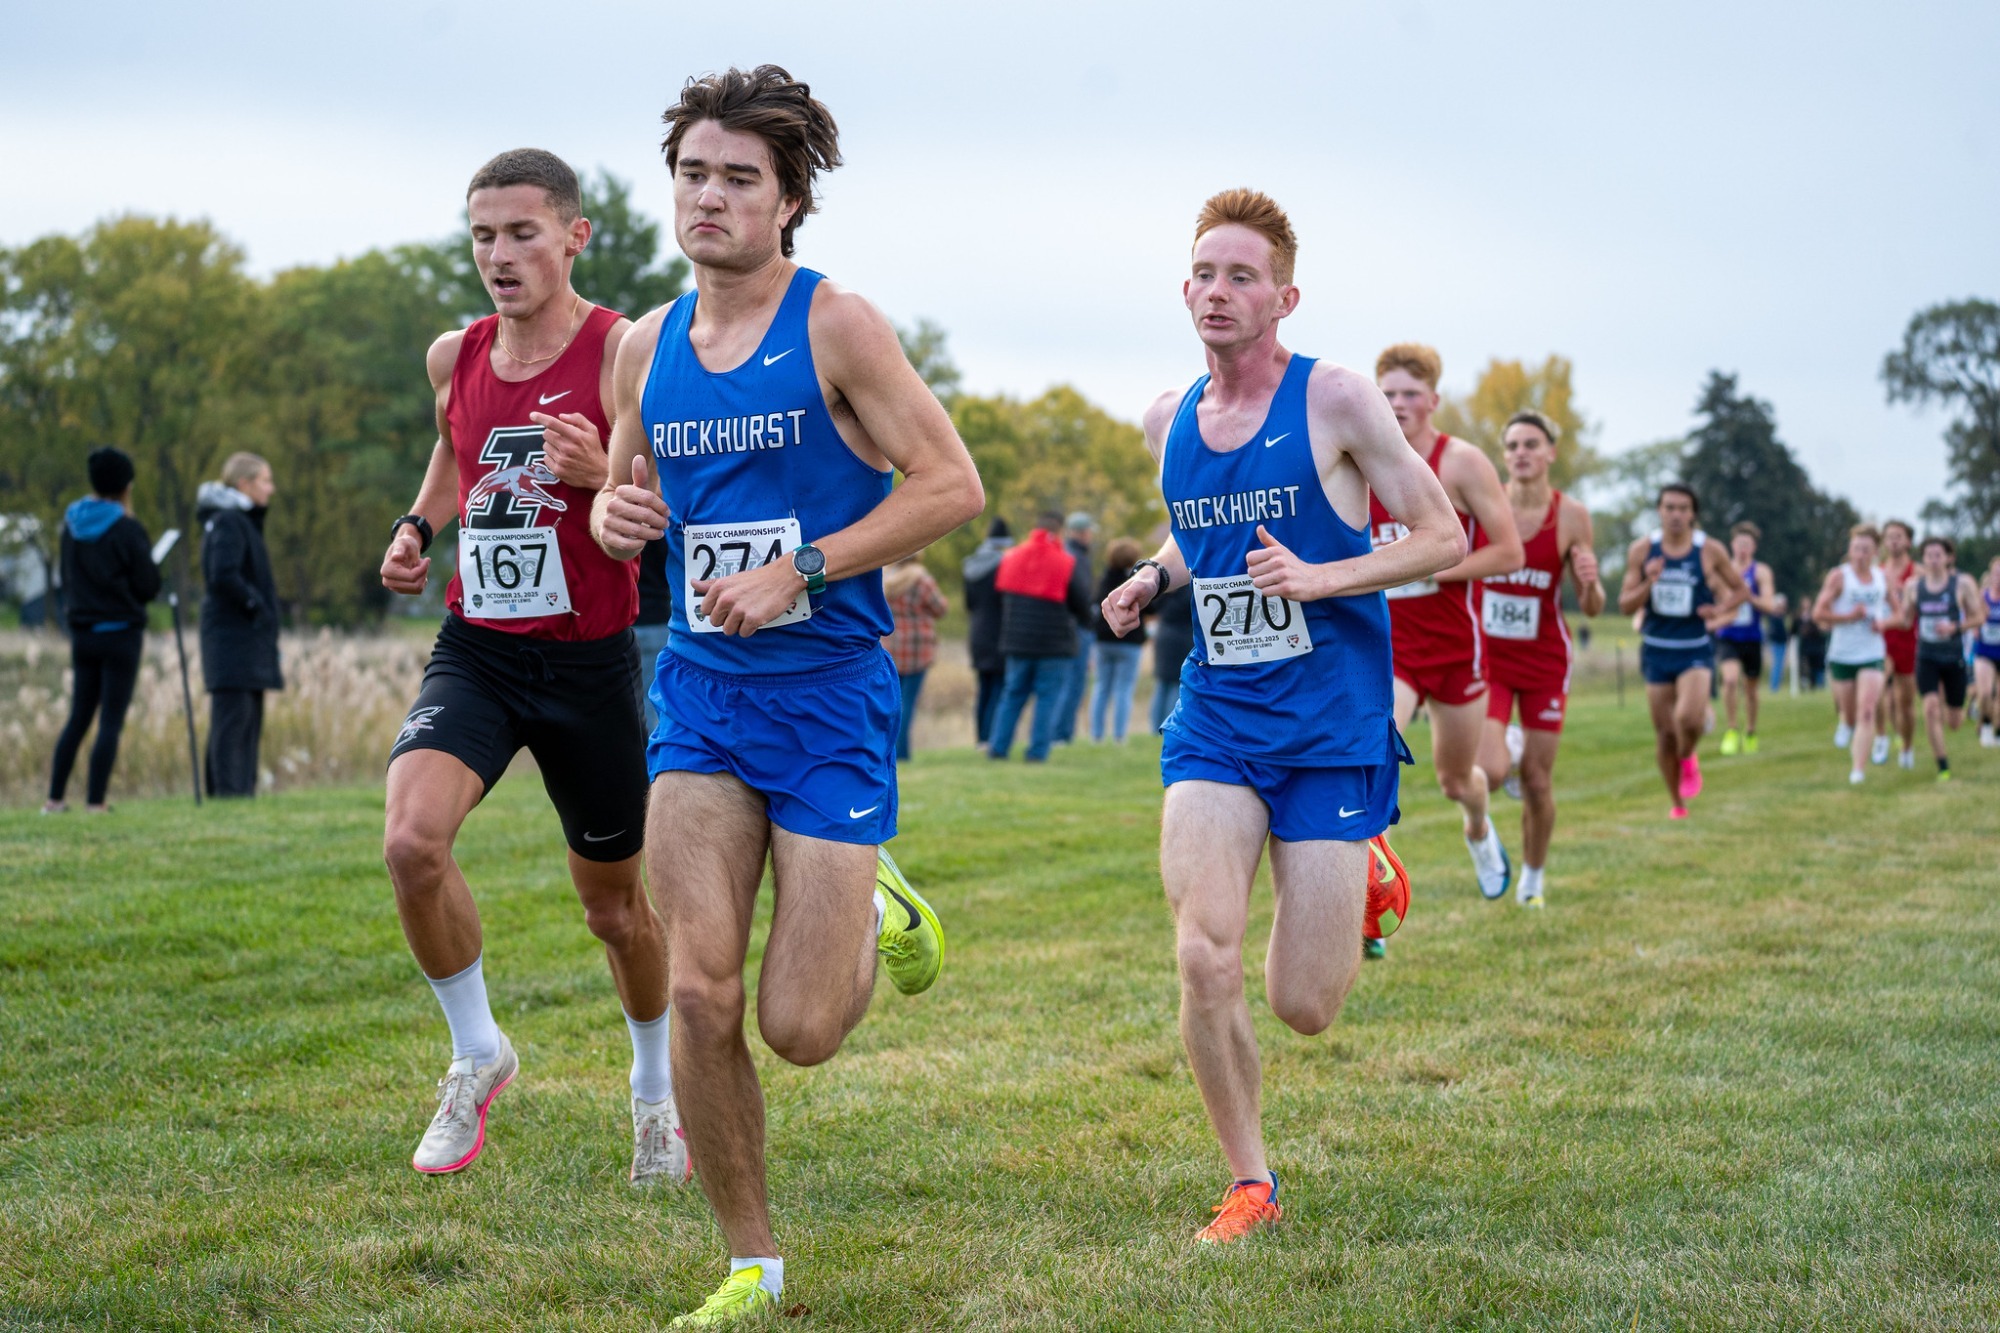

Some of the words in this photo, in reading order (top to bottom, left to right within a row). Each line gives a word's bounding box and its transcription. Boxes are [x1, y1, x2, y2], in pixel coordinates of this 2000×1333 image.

[652, 408, 807, 459] ROCKHURST
[1172, 485, 1300, 531] ROCKHURST
[492, 532, 545, 541] CHAMPIONSHIPS
[692, 532, 704, 540] 2025
[704, 530, 722, 539] GLVC
[723, 526, 786, 538] CHAMPIONSHIPS
[470, 543, 548, 589] 167
[1203, 590, 1292, 637] 270
[1491, 602, 1531, 625] 184
[1226, 638, 1254, 646] OCTOBER
